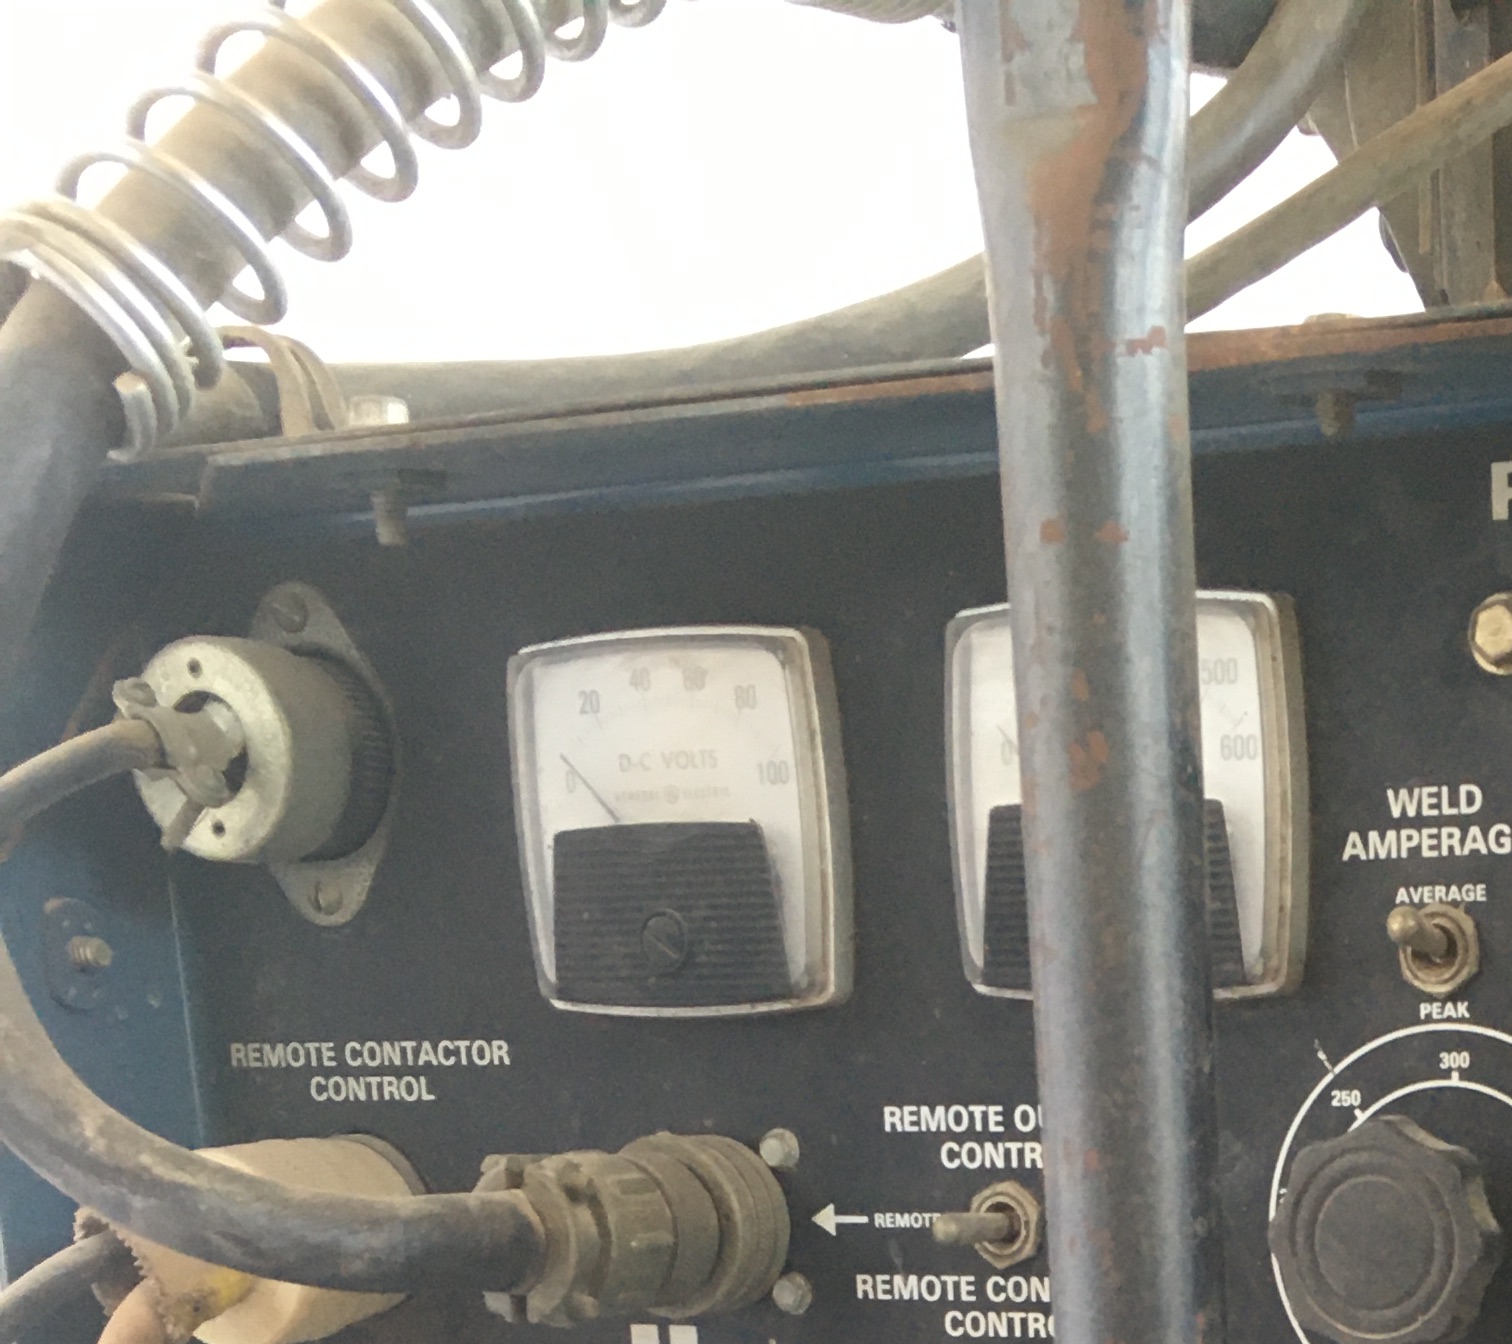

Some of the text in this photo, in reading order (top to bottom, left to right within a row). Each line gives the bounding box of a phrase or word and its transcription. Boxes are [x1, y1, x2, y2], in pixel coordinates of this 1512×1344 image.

[578, 689, 600, 714] 20
[1220, 734, 1259, 761] 600
[618, 749, 717, 773] D-C VOLTS
[756, 760, 790, 785] 100
[1386, 783, 1483, 819] WELD
[1395, 883, 1488, 903] AVERAGE
[1419, 1001, 1471, 1020] PEAK
[230, 1039, 511, 1068] REMOTE CONTACTOR
[1439, 1050, 1471, 1070] 300
[310, 1075, 436, 1102] CONTROL
[1330, 1089, 1362, 1107] 250
[883, 1104, 1005, 1132] REMOTE
[855, 1274, 976, 1302] REMOTE
